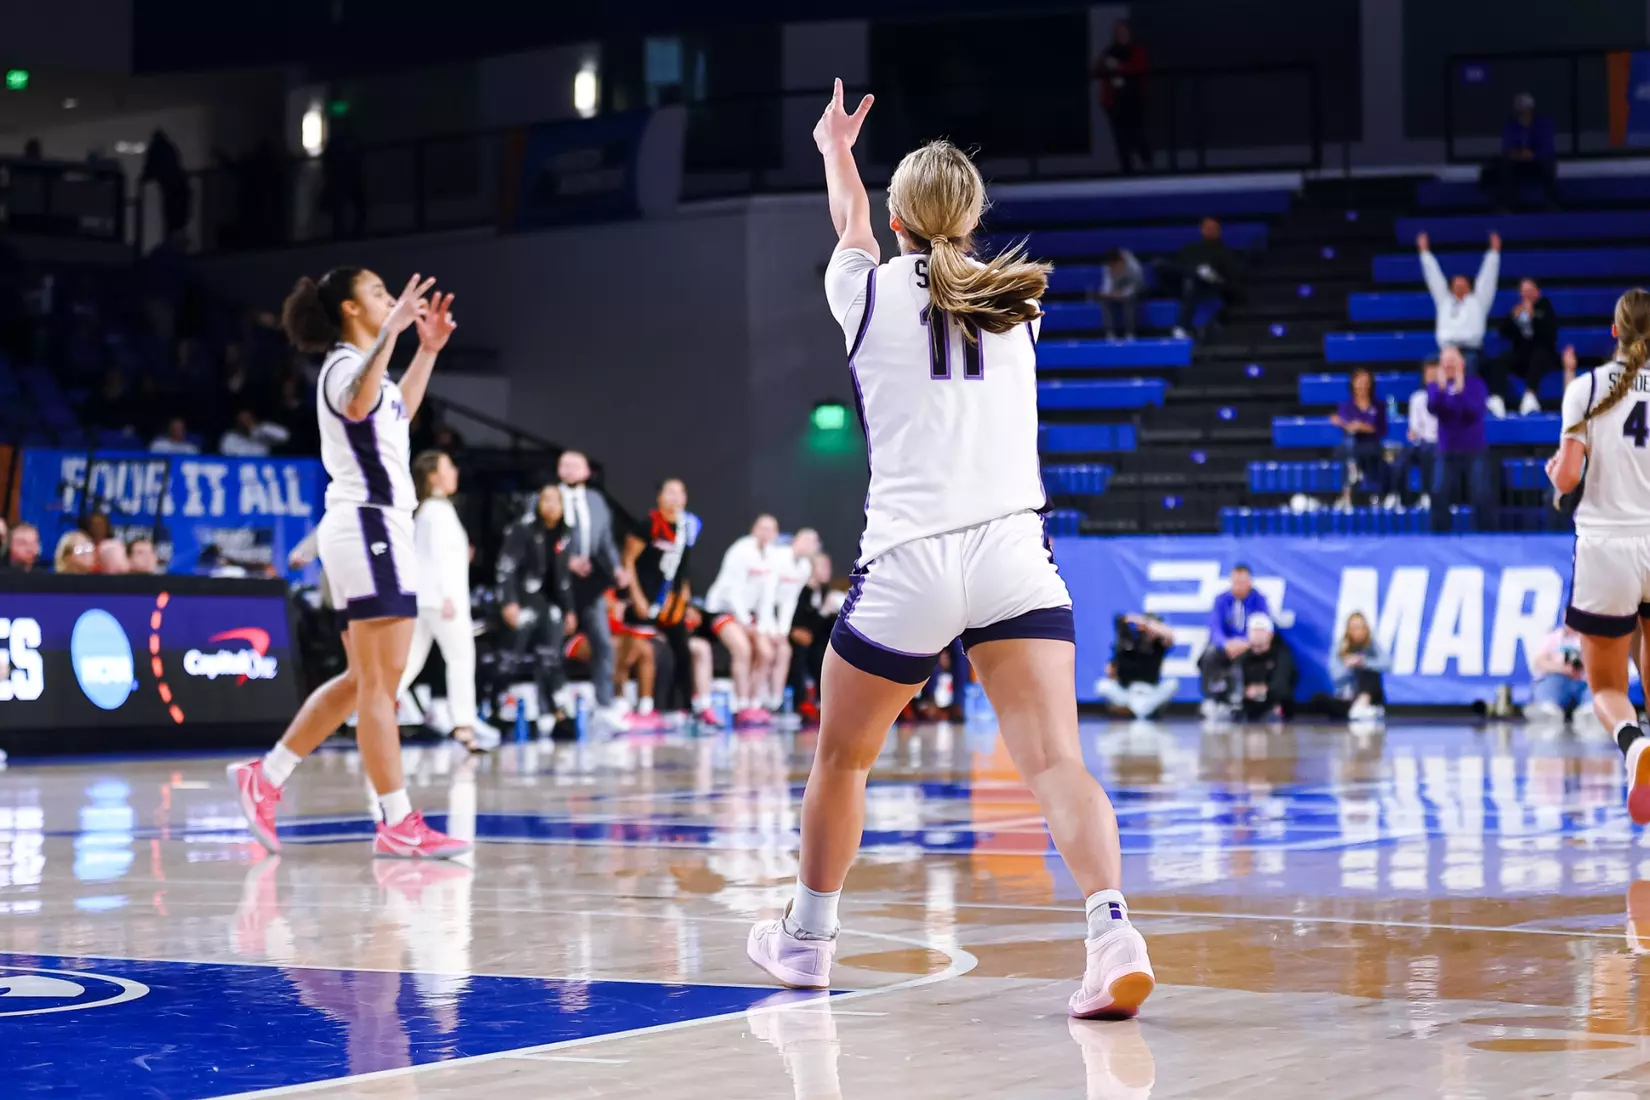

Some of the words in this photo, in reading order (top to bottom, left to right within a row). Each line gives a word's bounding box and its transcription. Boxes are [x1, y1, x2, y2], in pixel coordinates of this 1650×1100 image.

[919, 303, 985, 381] 11
[1622, 400, 1650, 449] 4
[182, 461, 228, 517] IT
[239, 463, 312, 517] ALL
